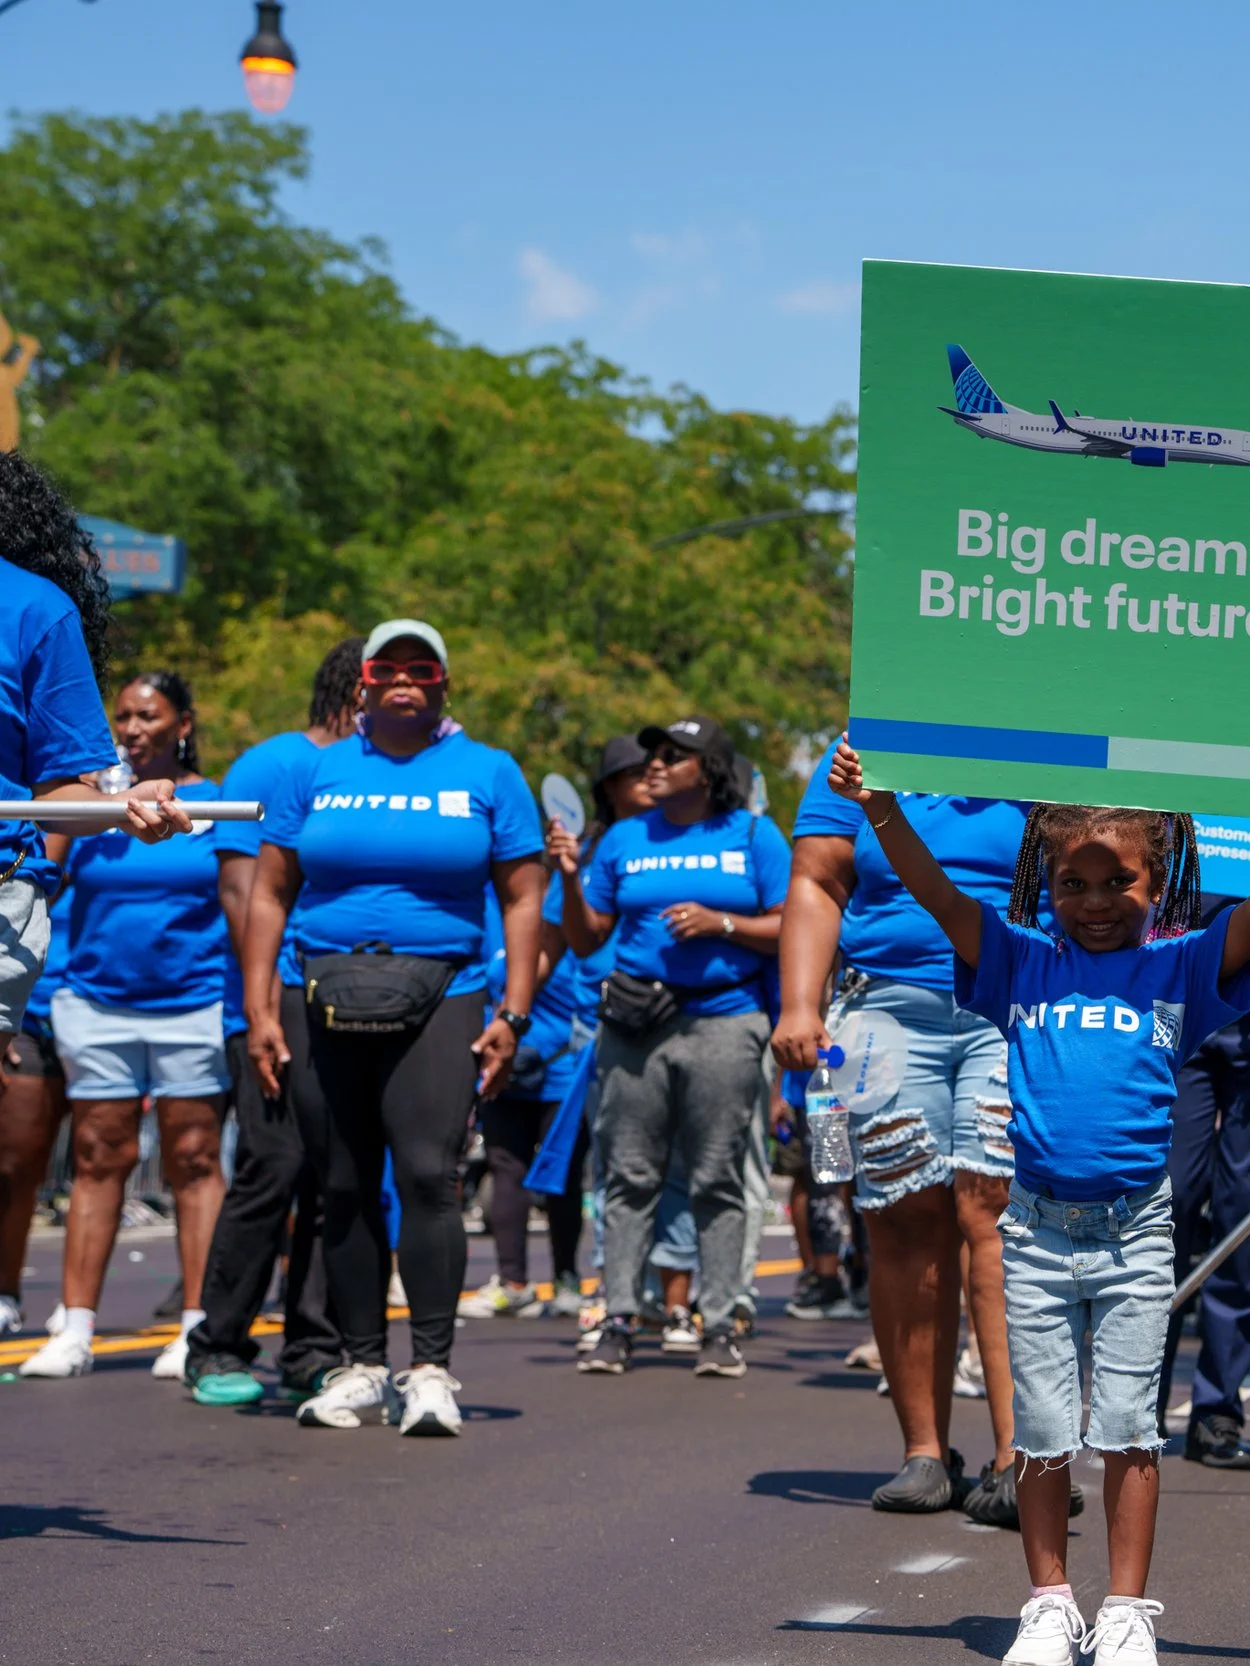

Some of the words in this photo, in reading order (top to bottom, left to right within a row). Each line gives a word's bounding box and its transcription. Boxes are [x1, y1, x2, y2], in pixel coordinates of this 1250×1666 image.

[1121, 426, 1223, 446] UNITED
[957, 508, 1046, 574] Big
[919, 569, 1092, 636] Bright
[313, 794, 432, 811] UNITED
[626, 854, 718, 874] UNITED
